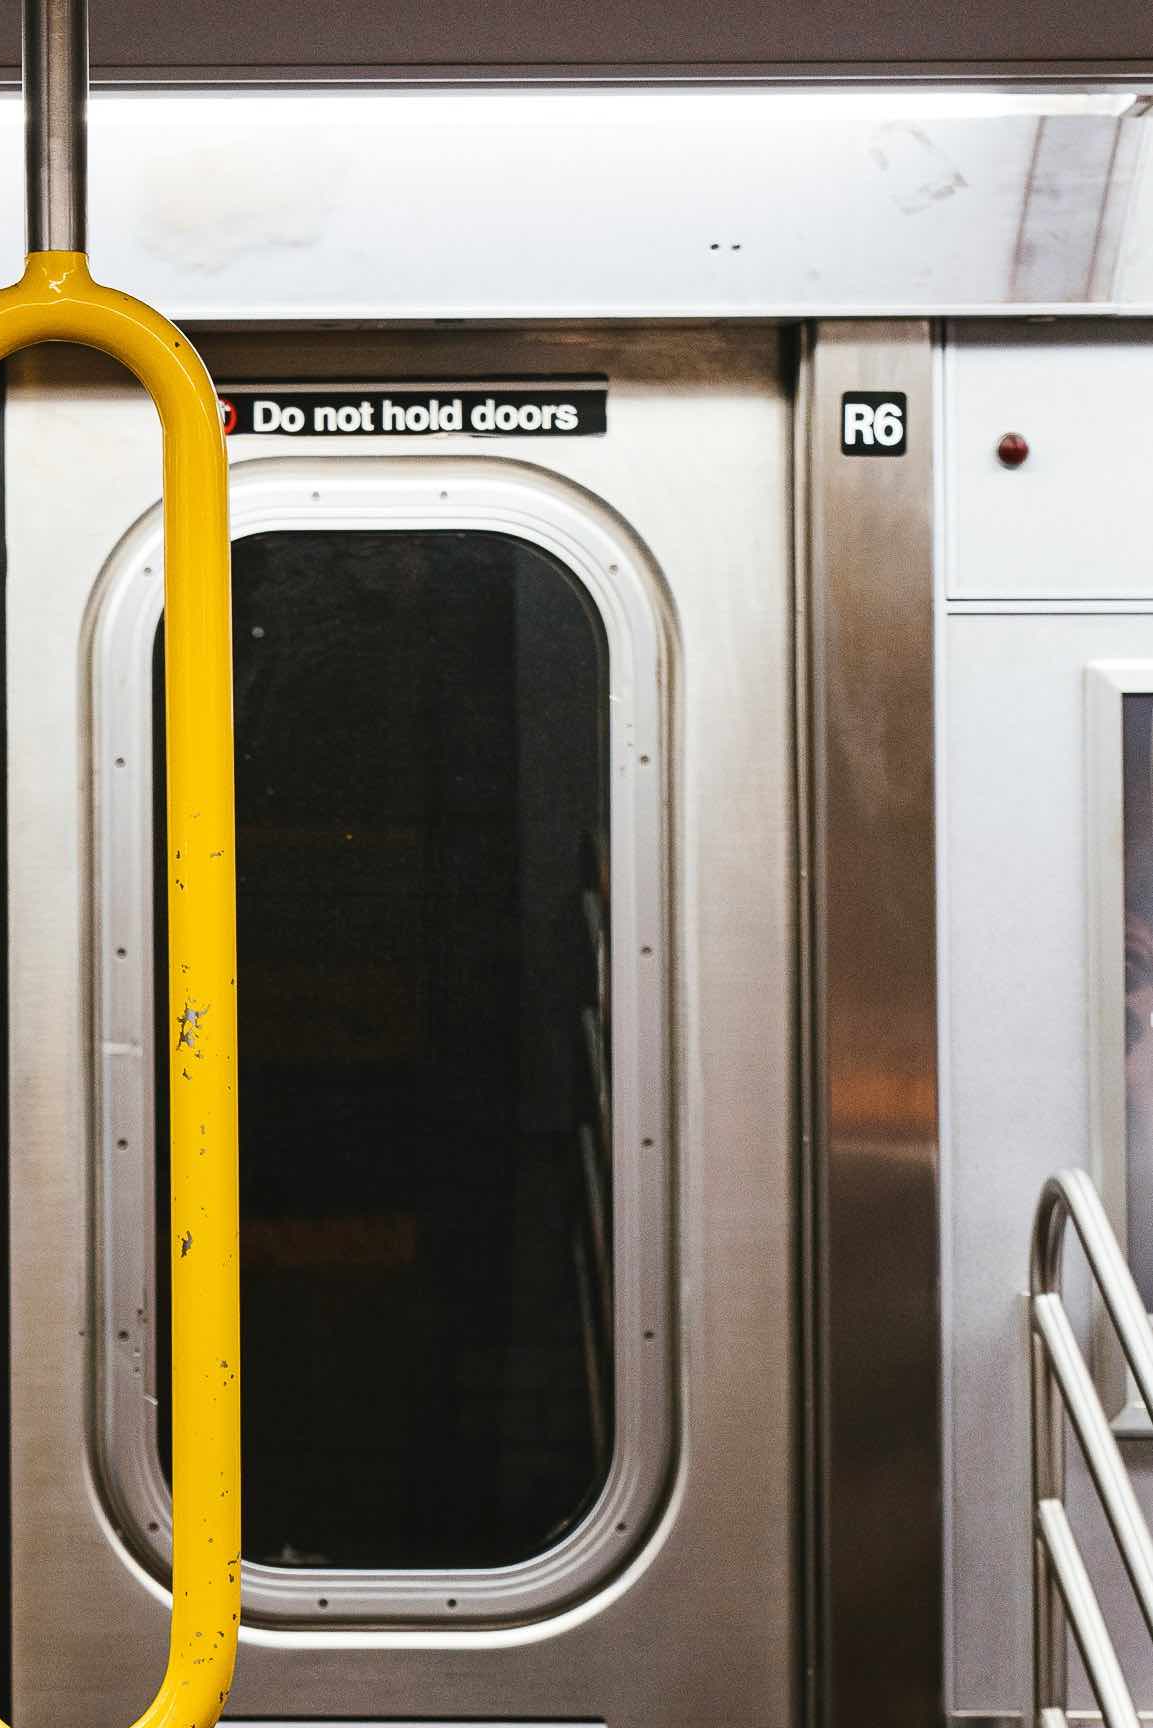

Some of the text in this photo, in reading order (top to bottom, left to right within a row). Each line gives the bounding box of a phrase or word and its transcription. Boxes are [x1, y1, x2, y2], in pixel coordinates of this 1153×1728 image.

[253, 398, 579, 432] Do not hold doors
[844, 402, 904, 447] R6
